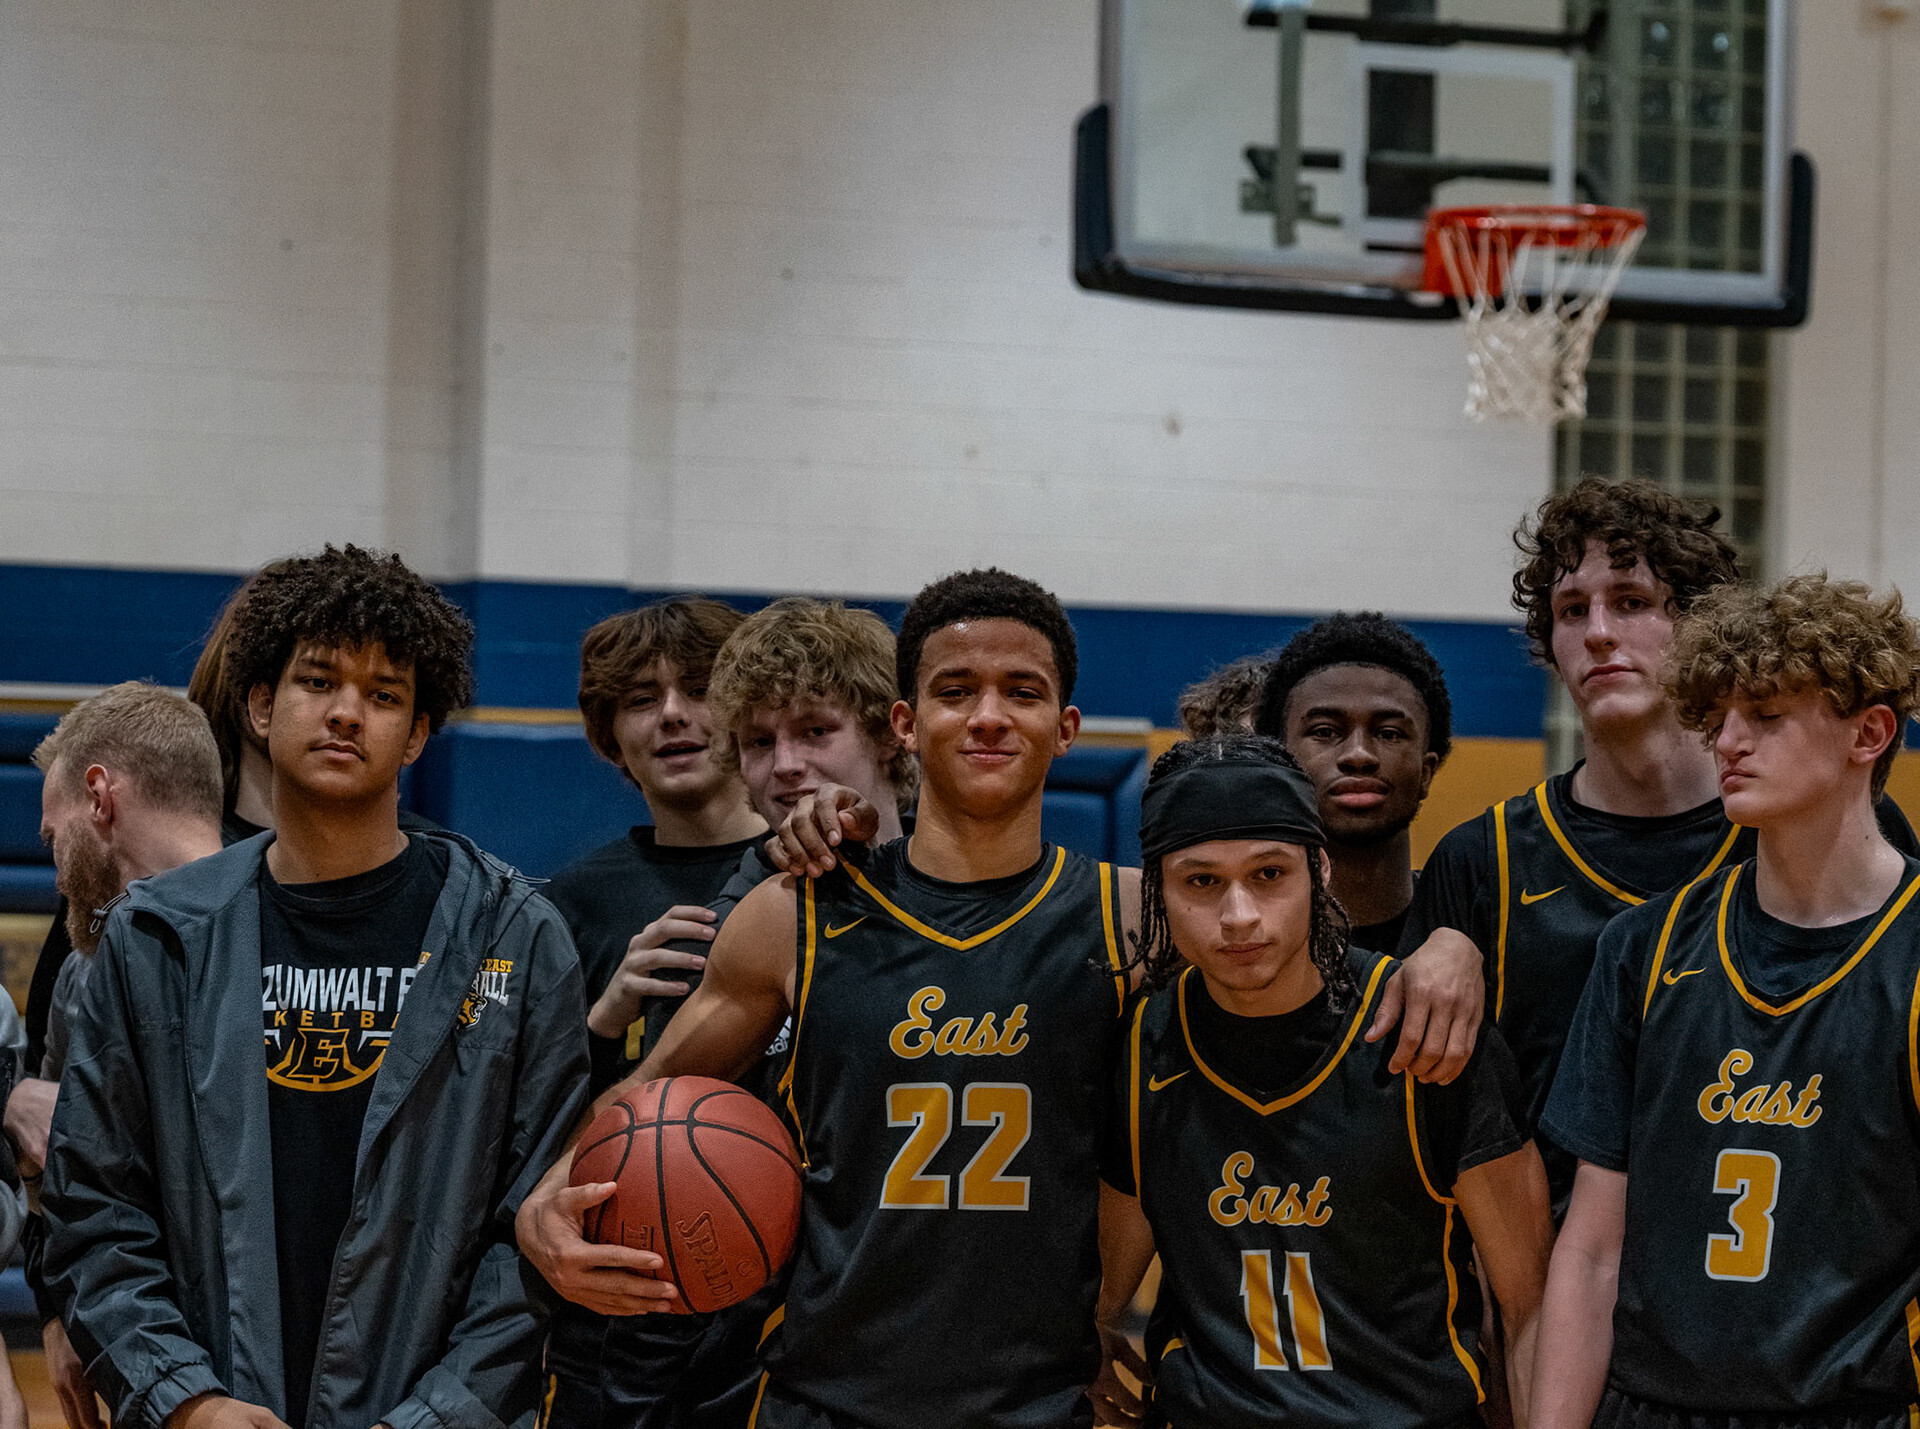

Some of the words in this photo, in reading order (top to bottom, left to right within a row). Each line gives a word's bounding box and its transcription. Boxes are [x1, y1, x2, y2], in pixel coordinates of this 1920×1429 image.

[262, 964, 393, 1012] ZUMWALT
[485, 958, 513, 973] EAST
[889, 985, 1030, 1059] East
[1697, 1048, 1823, 1128] East
[879, 1081, 1032, 1211] 22
[1208, 1150, 1333, 1227] East
[1704, 1148, 1782, 1283] 3
[1239, 1249, 1333, 1371] 11
